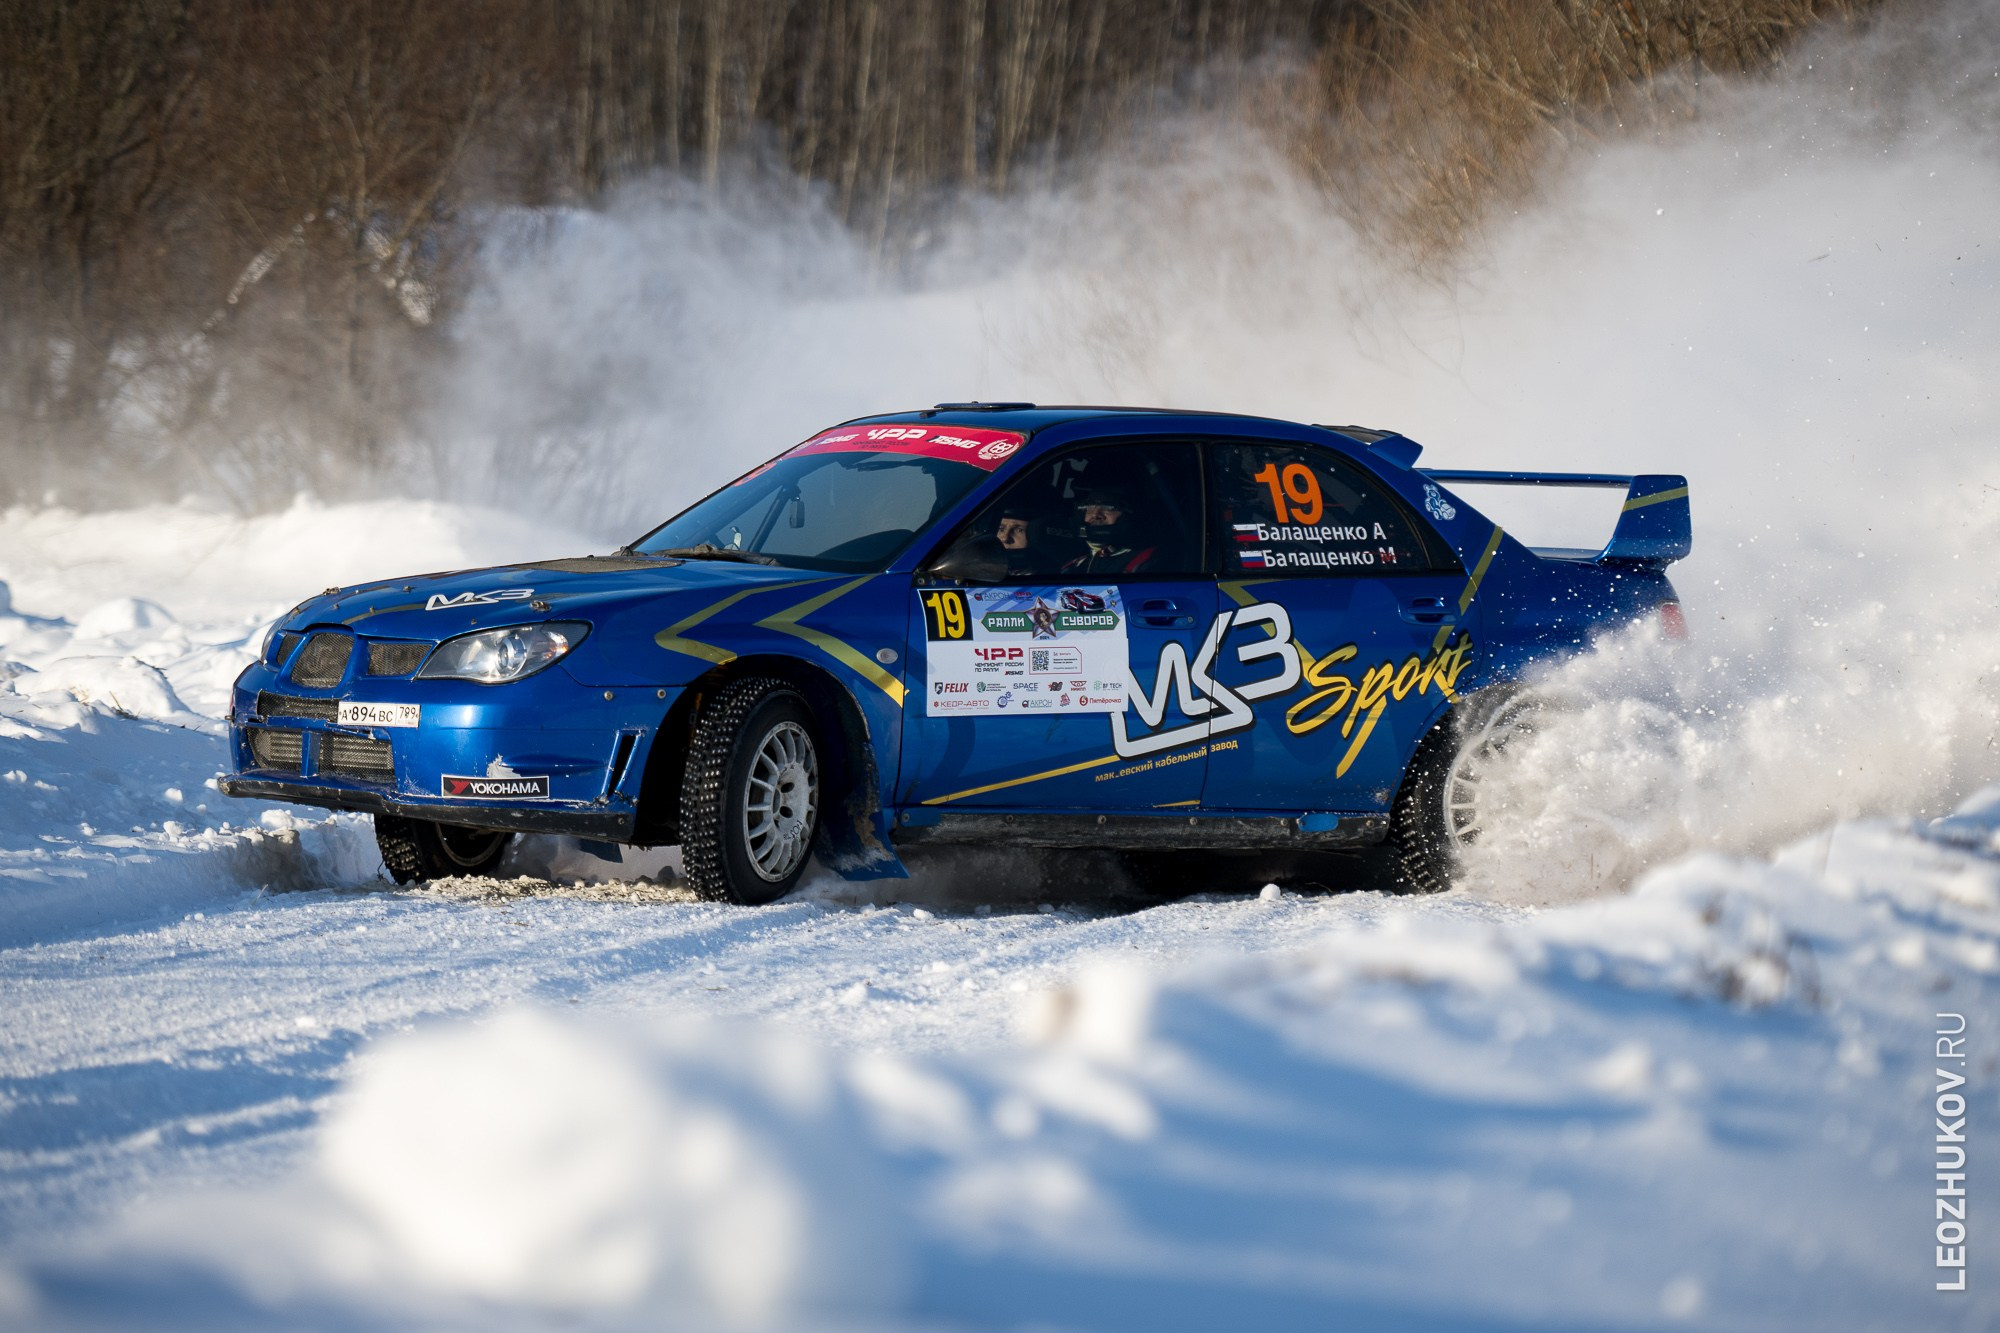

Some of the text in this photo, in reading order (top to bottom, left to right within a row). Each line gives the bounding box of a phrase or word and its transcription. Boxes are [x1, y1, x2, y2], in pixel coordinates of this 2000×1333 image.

[1254, 463, 1324, 525] 19
[1256, 521, 1387, 544] Балащенко А
[1262, 546, 1397, 569] Балащенко М
[926, 591, 966, 639] 19
[988, 615, 1114, 628] РАЛЛИ СУВОРОВ
[974, 647, 1024, 661] ЧРР
[944, 682, 970, 693] FELIX
[1013, 682, 1039, 690] SPACE
[940, 700, 990, 708] КЕДР-АВТО
[1285, 631, 1474, 780] Sport
[1155, 746, 1208, 769] кабельный
[1210, 739, 1239, 753] завод
[470, 781, 541, 795] YOKOHAMA
